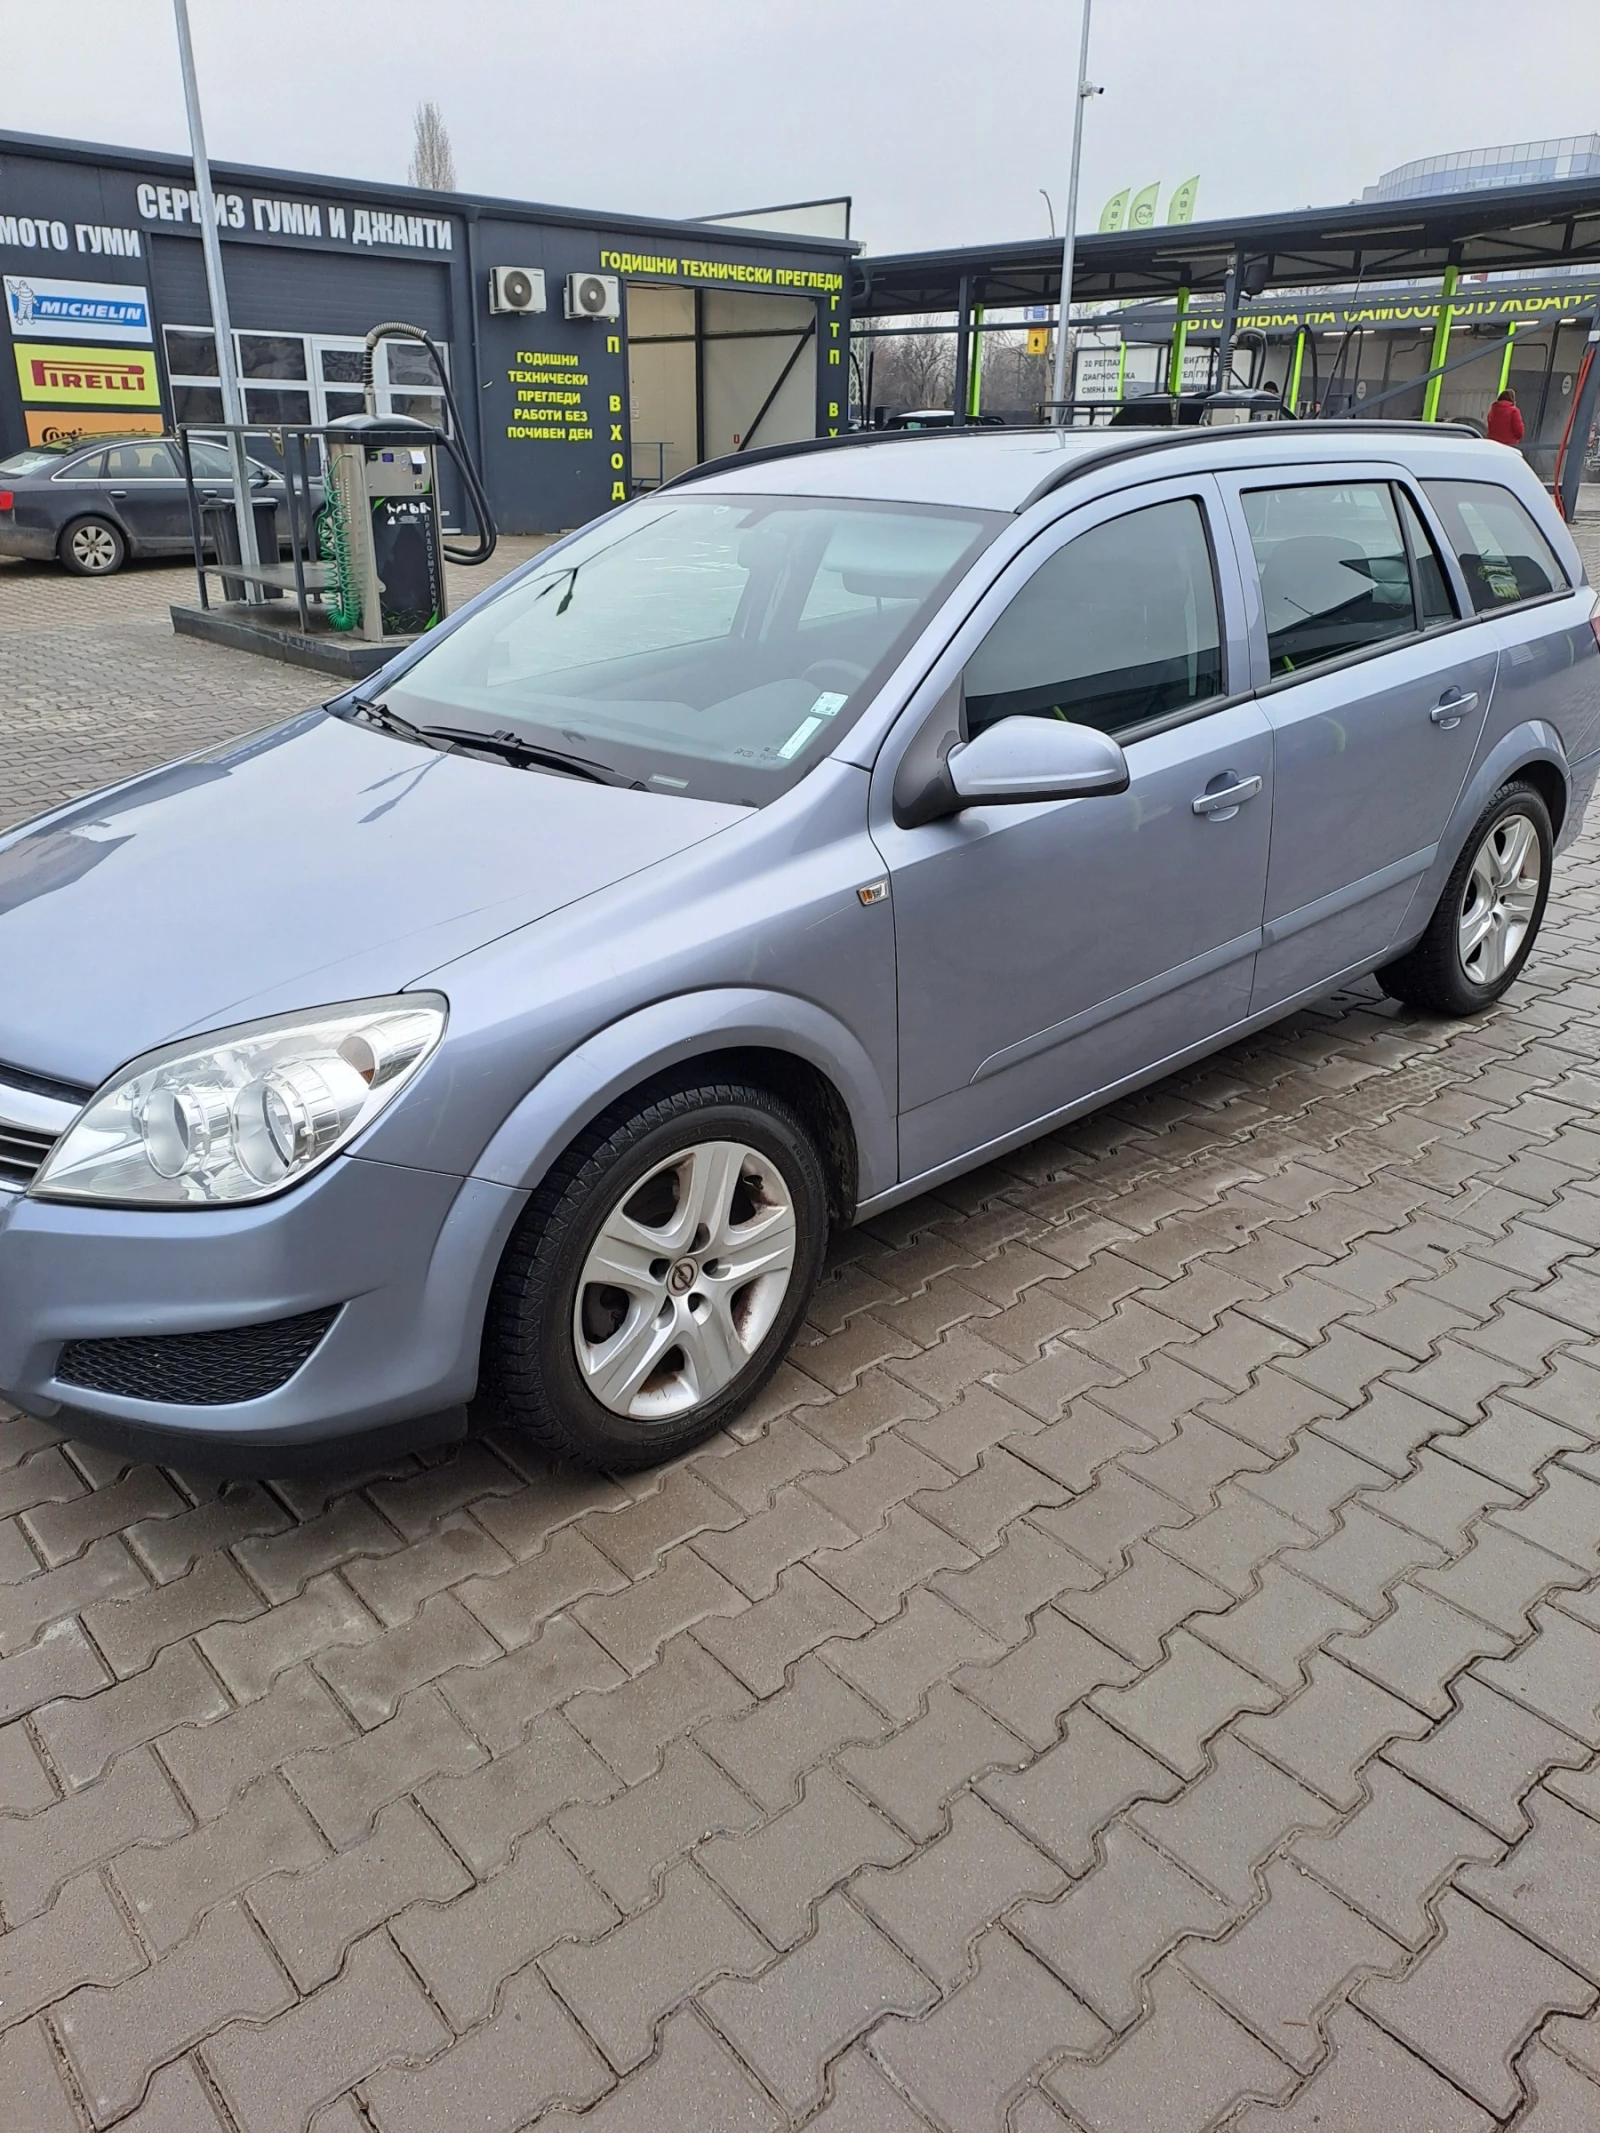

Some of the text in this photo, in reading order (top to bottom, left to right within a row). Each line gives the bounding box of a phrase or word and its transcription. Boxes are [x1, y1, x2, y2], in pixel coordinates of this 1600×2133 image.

[252, 197, 322, 237] ГУМИ
[327, 206, 346, 239] И
[351, 209, 452, 250] ДЖАНТИ
[0, 215, 141, 258] МОТО ГУМИ
[600, 250, 843, 291] ГОДИШНИ ТЕХНИЧЕСКИ ПРЕГЛЕДИ
[40, 300, 142, 320] MICHELIN
[516, 351, 579, 366] ГОДИШНИ
[31, 359, 145, 391] PIRELLI
[507, 370, 589, 386] ТЕХНИЧЕСКИ
[1082, 372, 1135, 382] ДИАГНОСТКА
[517, 390, 581, 405] ПРЕГЛЕДИ
[513, 408, 588, 422] РАБОТИ БЕЗ
[507, 426, 593, 441] ПОЧИВЕН ДЕН
